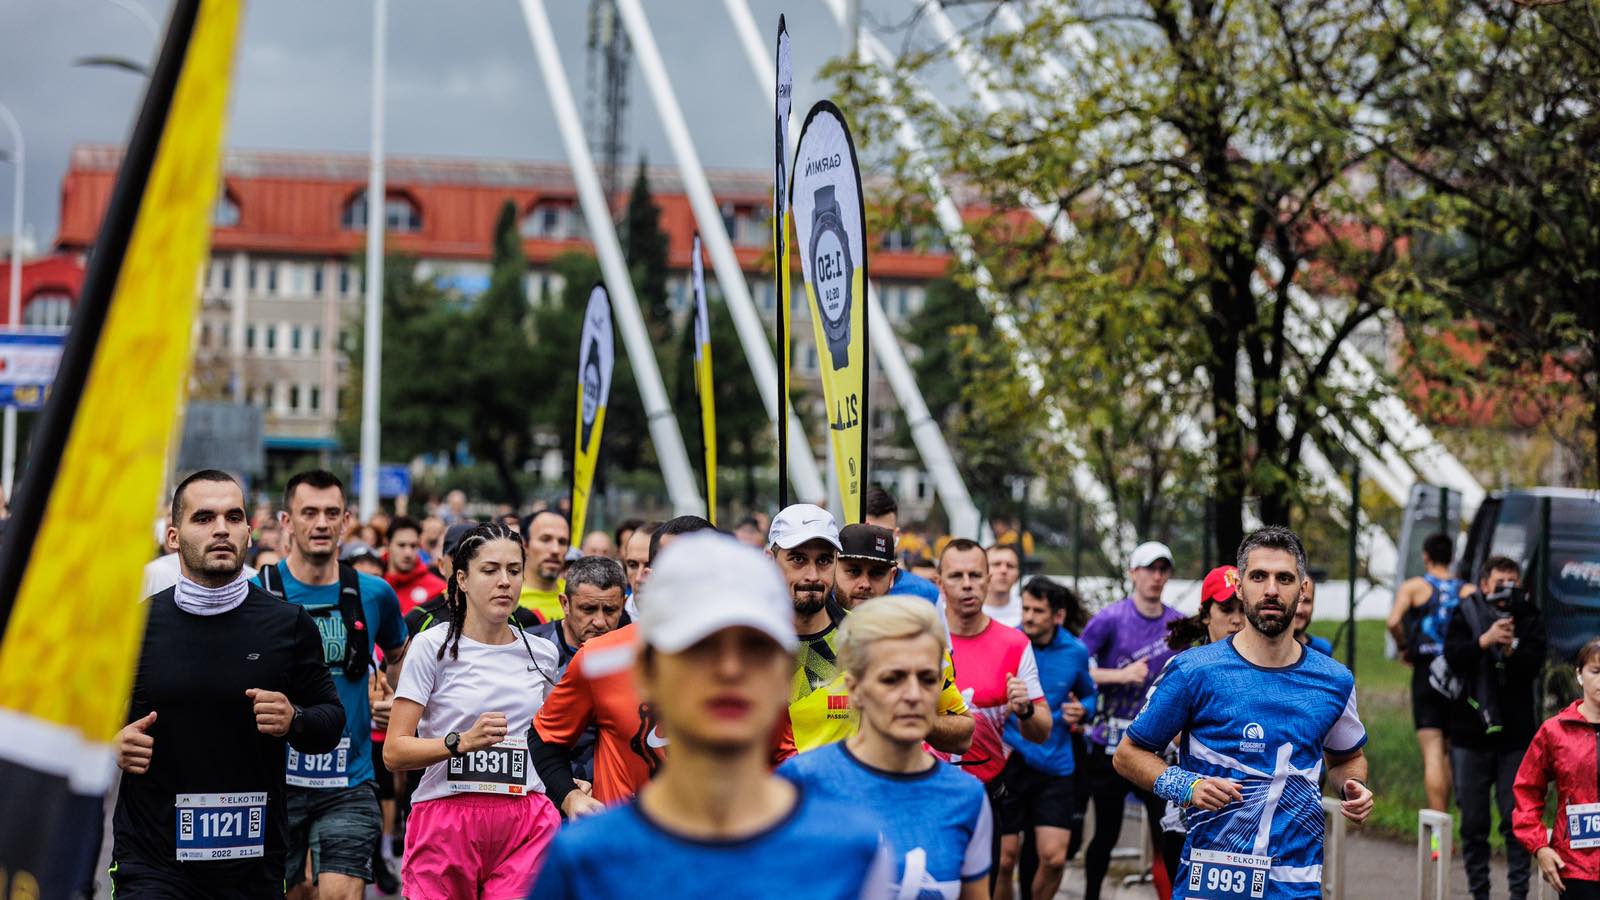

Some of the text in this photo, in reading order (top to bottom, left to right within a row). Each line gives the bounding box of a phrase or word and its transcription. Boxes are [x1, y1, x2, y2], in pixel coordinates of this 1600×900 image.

[304, 752, 333, 771] 912
[466, 750, 508, 774] 1331
[227, 795, 264, 804] ELKO TIM
[199, 811, 243, 838] 1121
[211, 849, 232, 858] 2022
[1232, 855, 1268, 867] ELKO TIM
[1207, 867, 1247, 894] 993
